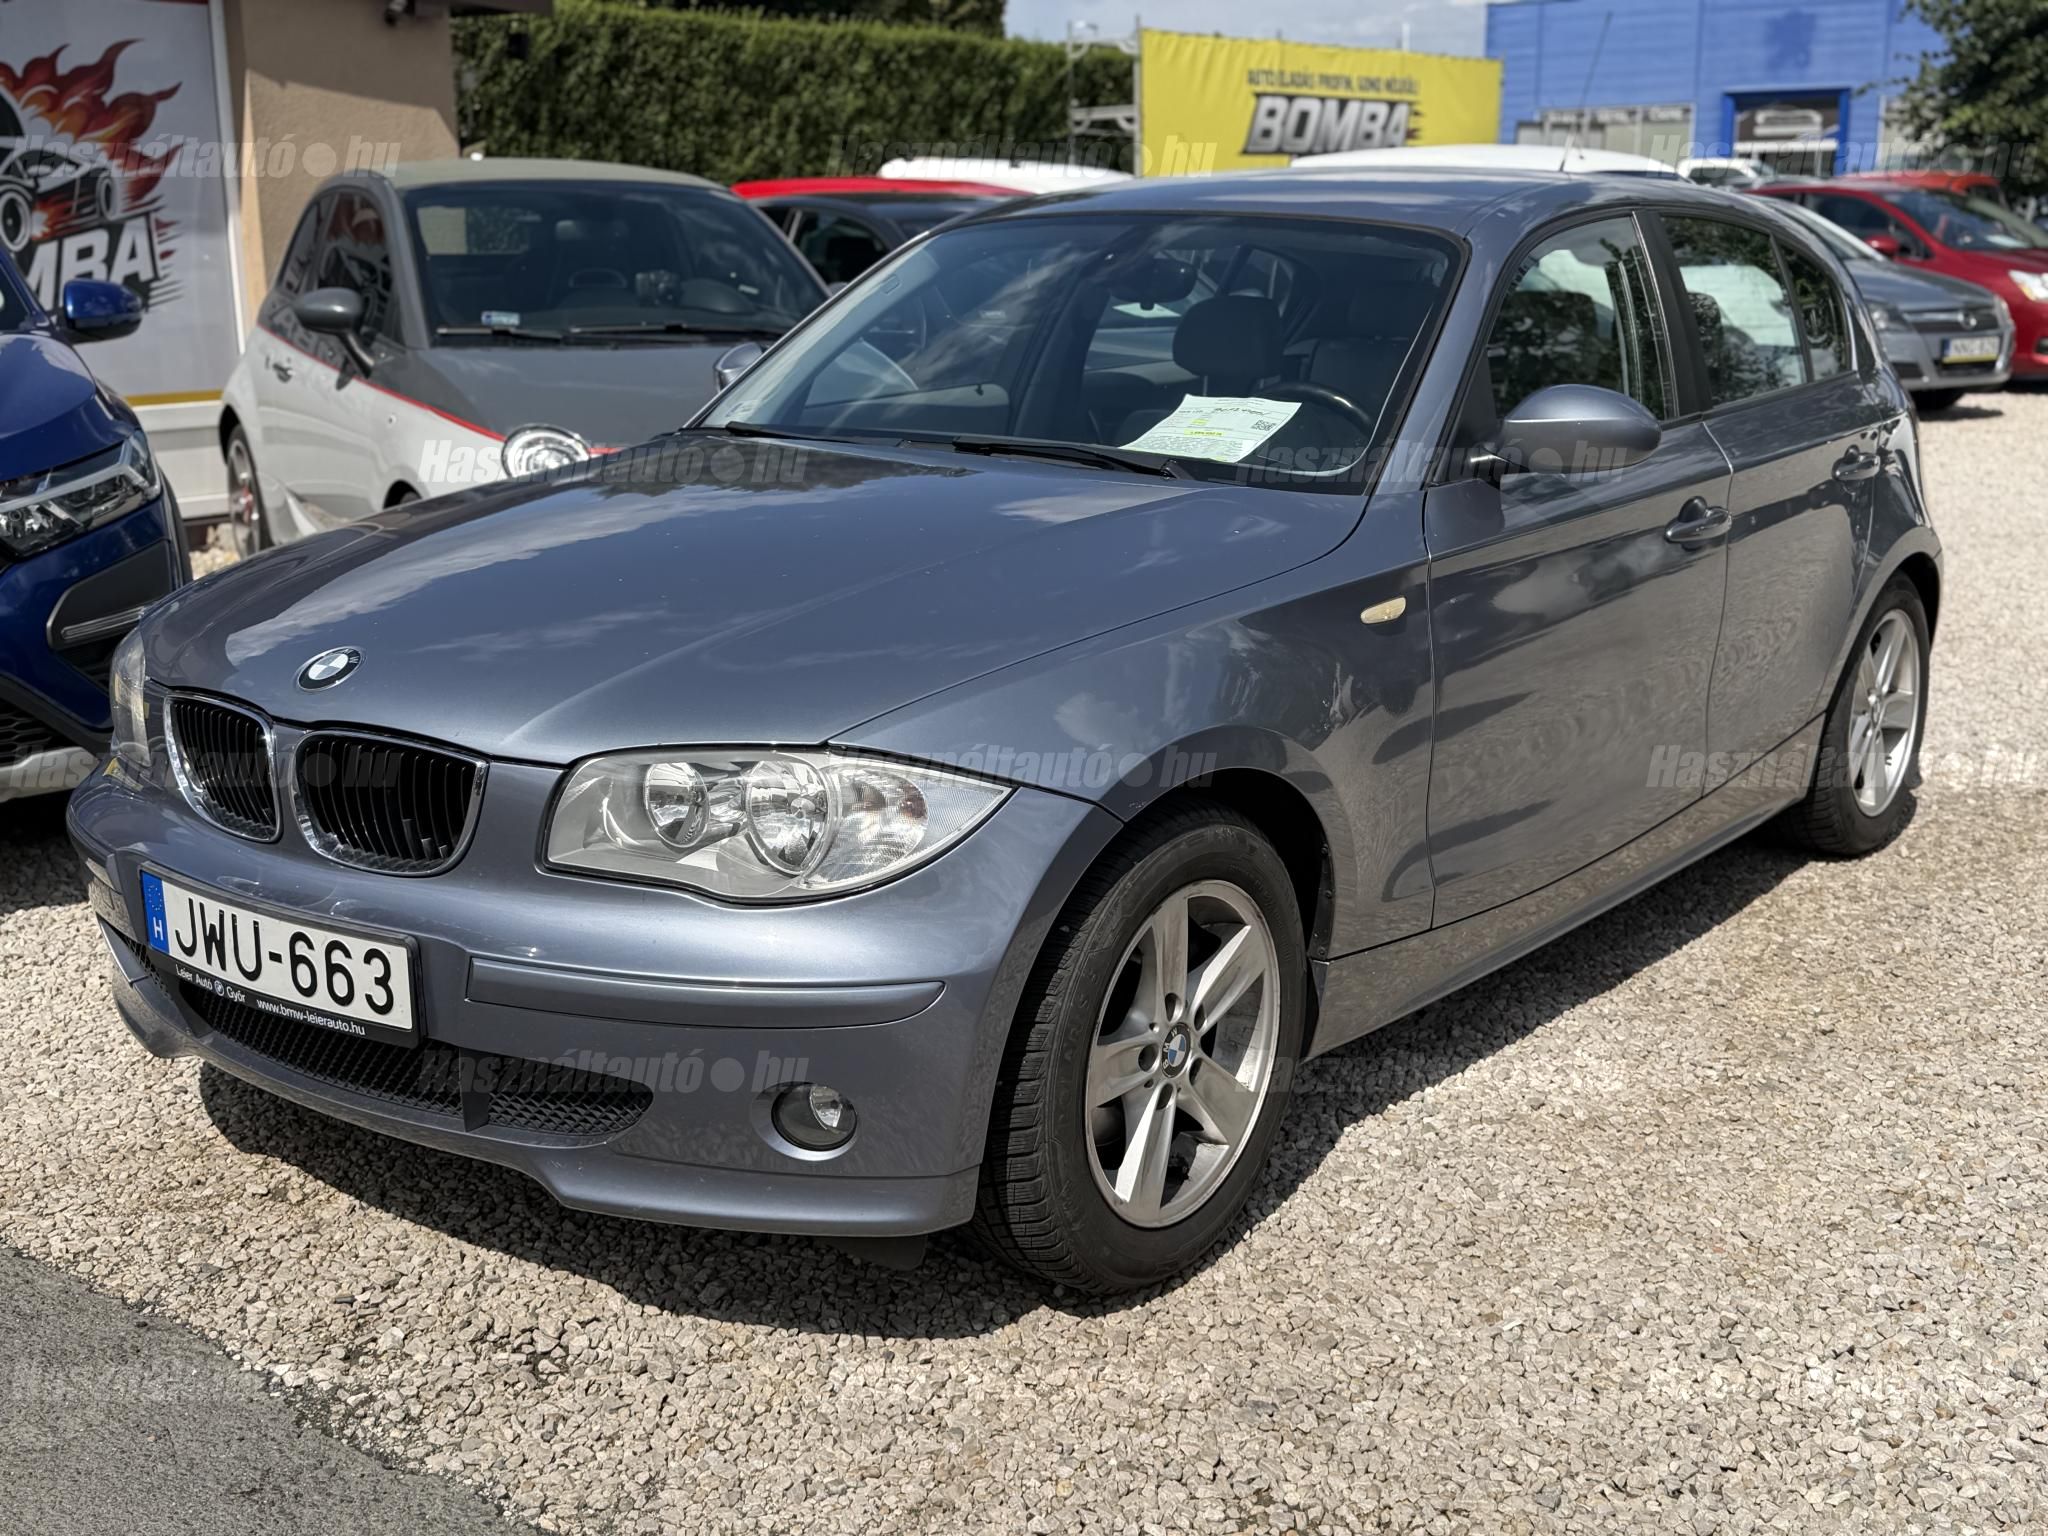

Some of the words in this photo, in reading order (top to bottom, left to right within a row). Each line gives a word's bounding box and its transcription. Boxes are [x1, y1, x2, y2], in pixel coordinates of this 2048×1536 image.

[1246, 95, 1410, 153] BOMBA
[153, 917, 165, 941] H
[175, 897, 395, 1015] JWU-663
[256, 999, 366, 1036] www.bmw-leierauto.hu
